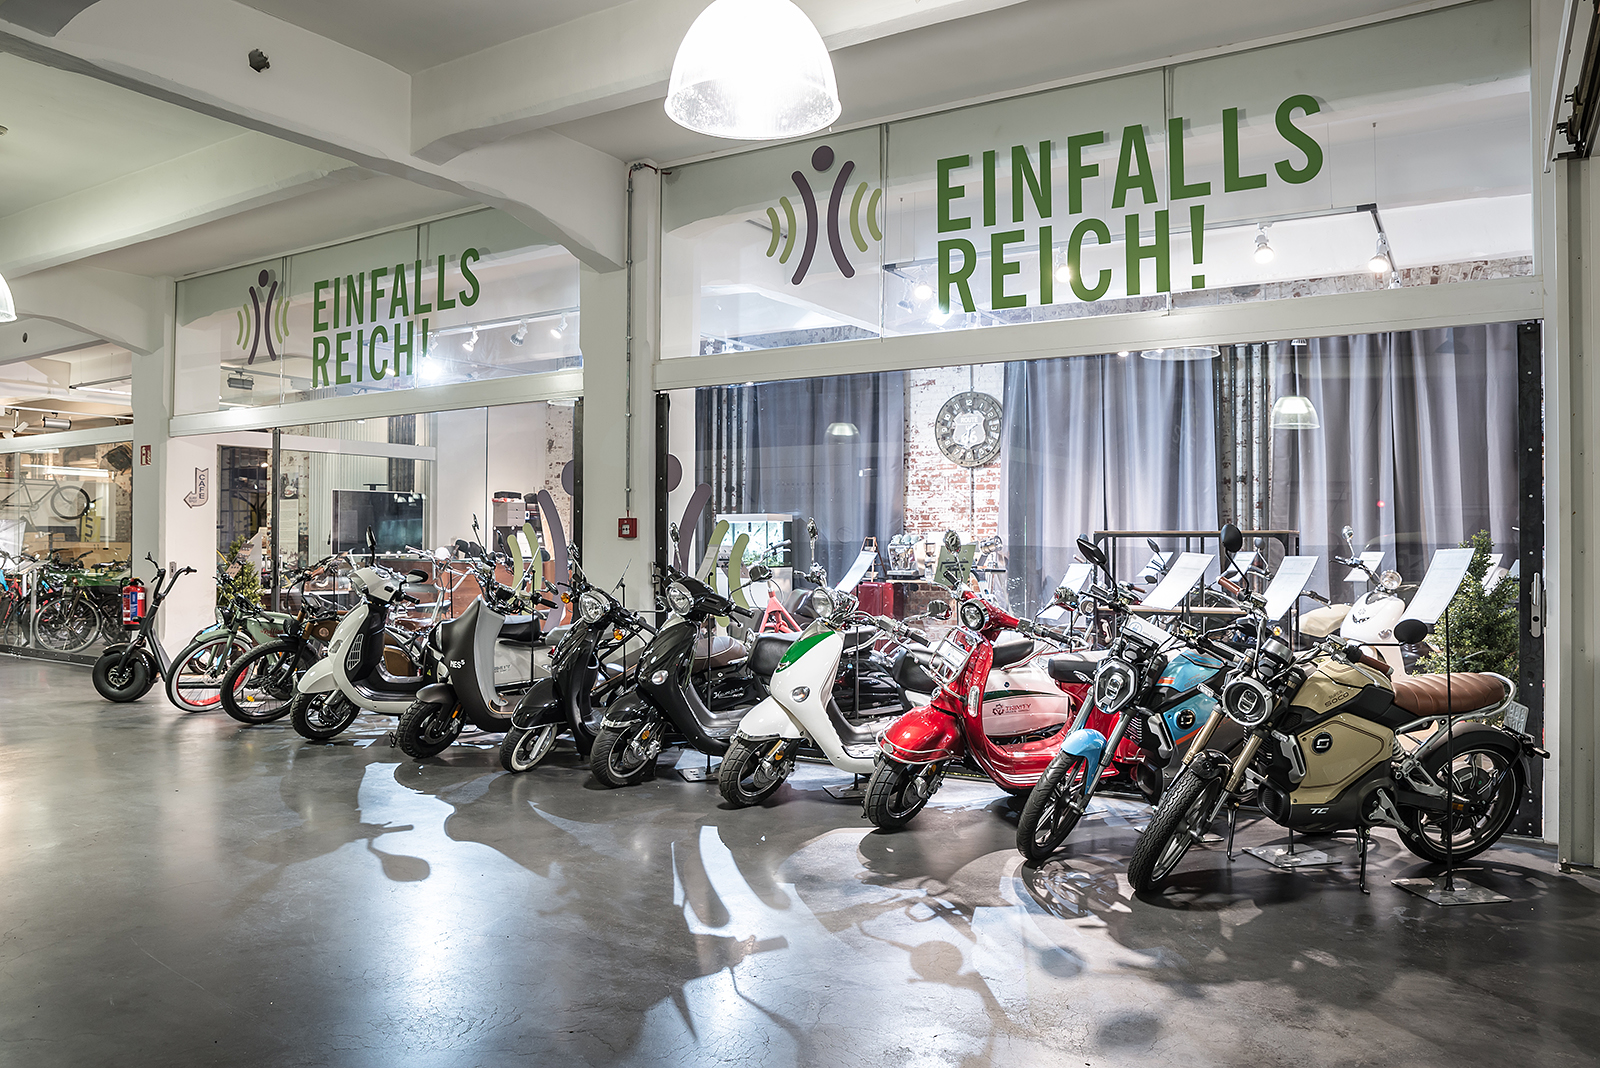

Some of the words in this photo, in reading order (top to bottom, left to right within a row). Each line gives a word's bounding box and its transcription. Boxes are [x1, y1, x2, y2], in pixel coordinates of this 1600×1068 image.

[936, 94, 1323, 234] EINFALLS
[313, 247, 480, 333] EINFALLS
[937, 204, 1206, 314] REICH!
[312, 318, 429, 388] REICH!
[198, 473, 206, 500] CAFE
[1324, 692, 1350, 708] SOCO
[1310, 807, 1330, 815] TC
